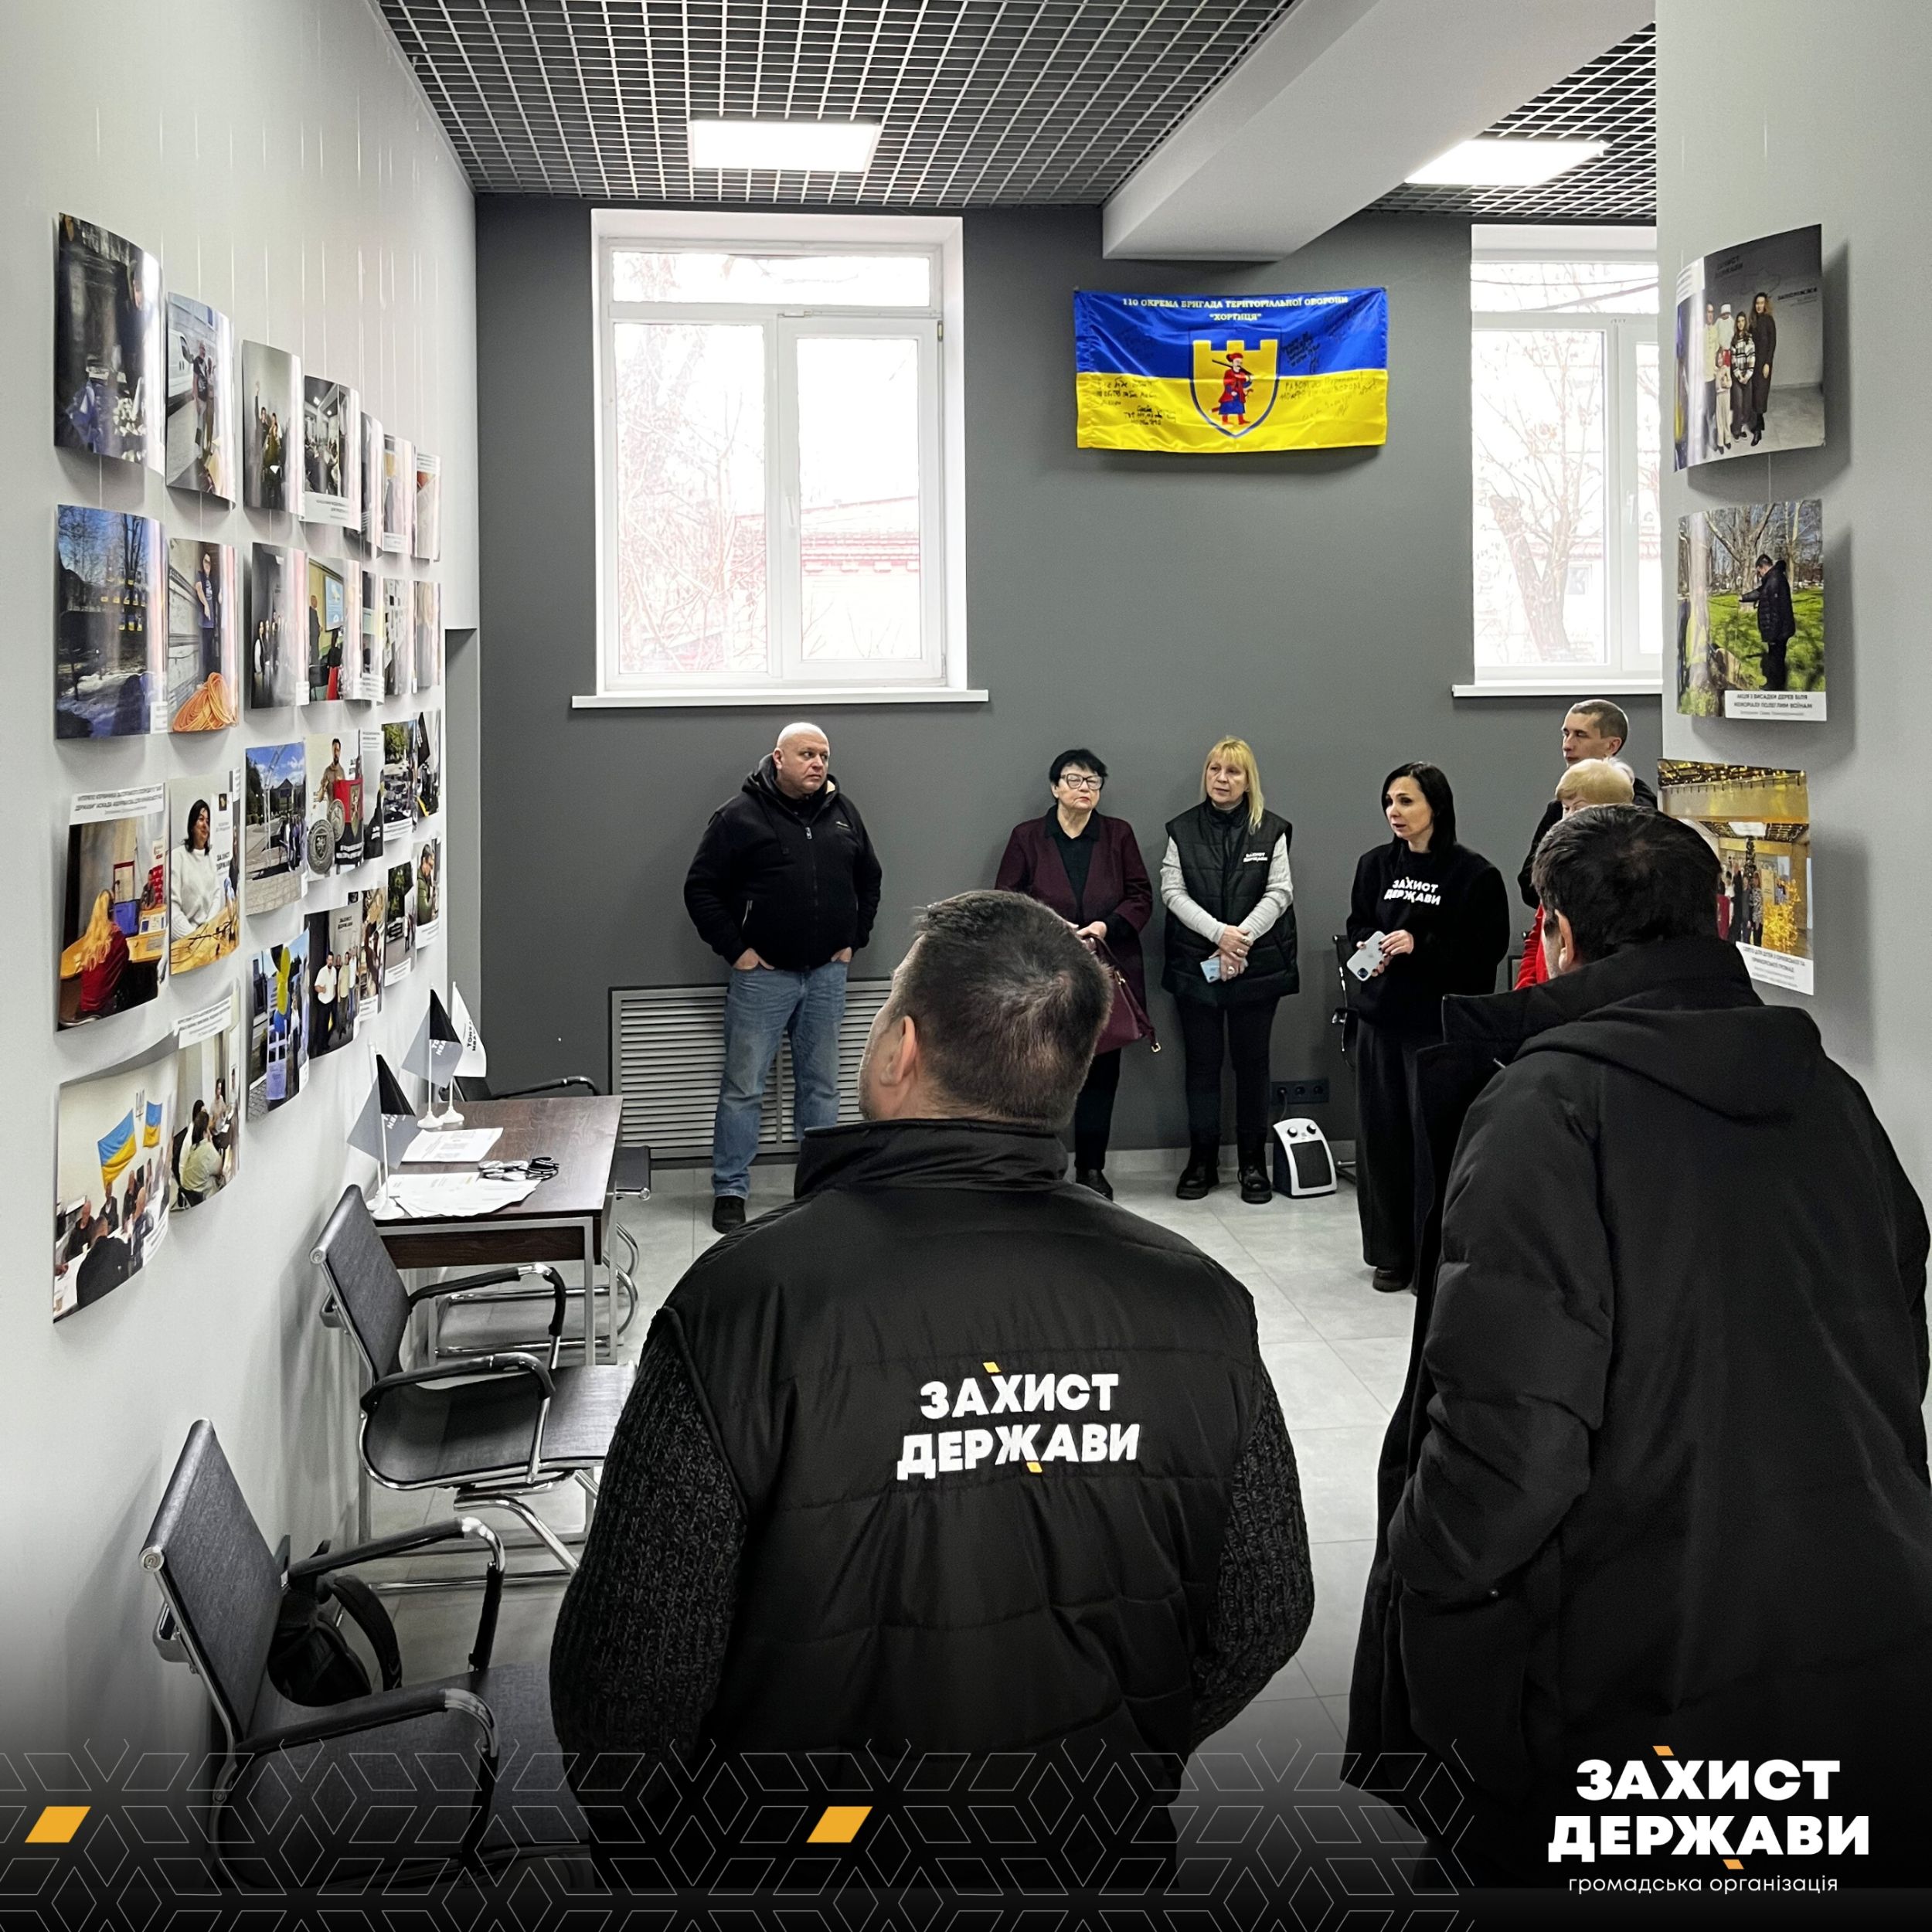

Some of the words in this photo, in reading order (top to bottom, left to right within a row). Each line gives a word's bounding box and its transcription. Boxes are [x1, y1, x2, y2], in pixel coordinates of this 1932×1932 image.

[1123, 298, 1138, 307] 110
[1181, 300, 1223, 308] БРИГАДА
[1392, 878, 1439, 893] ЗАХИСТ
[1383, 889, 1442, 906] ДЕРЖАВИ
[920, 1372, 1119, 1420] ЗАХИСТ
[896, 1423, 1141, 1481] ДЕРЖАВИ
